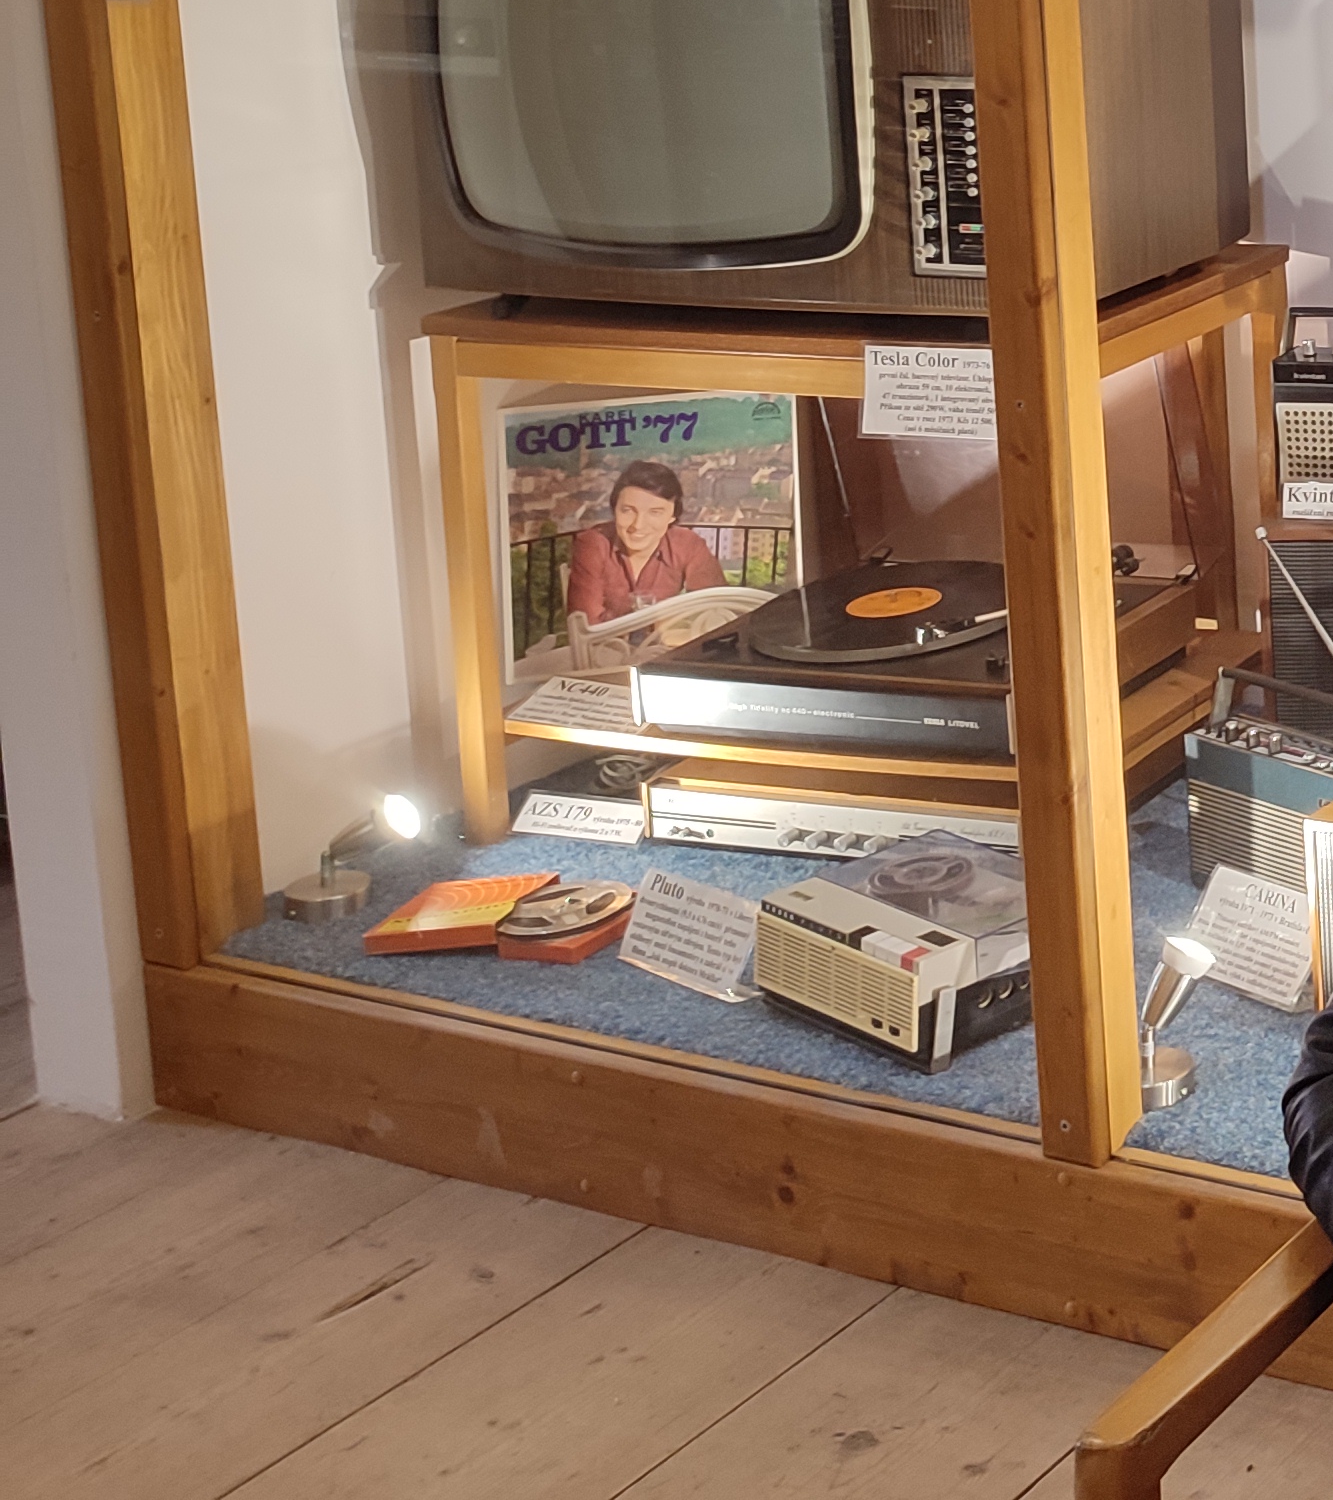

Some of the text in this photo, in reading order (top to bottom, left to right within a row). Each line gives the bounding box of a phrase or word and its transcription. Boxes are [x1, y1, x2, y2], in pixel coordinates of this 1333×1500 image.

[870, 351, 909, 366] Tesla
[916, 352, 959, 368] Color
[580, 410, 635, 425] KAREL
[516, 419, 636, 455] GOTT
[948, 720, 980, 729] LITOVEL
[524, 801, 592, 821] AZS 179
[650, 873, 684, 899] Pluto
[1245, 884, 1297, 913] CARINA
